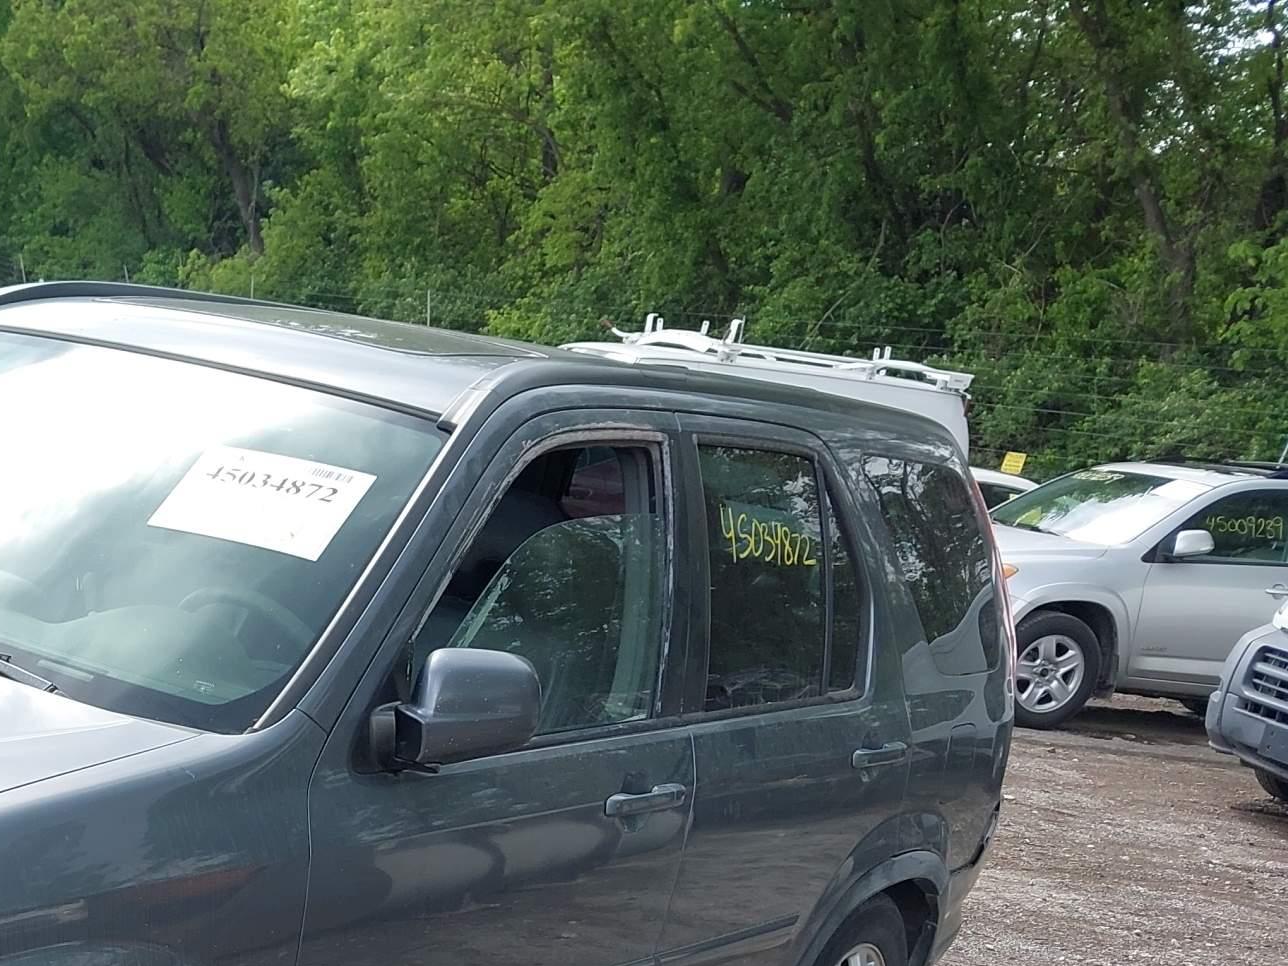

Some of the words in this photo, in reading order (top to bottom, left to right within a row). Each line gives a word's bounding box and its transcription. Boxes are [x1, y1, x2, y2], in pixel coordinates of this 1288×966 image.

[205, 464, 340, 504] 45034872
[719, 503, 817, 566] 45034872
[1206, 515, 1284, 540] 45009239
